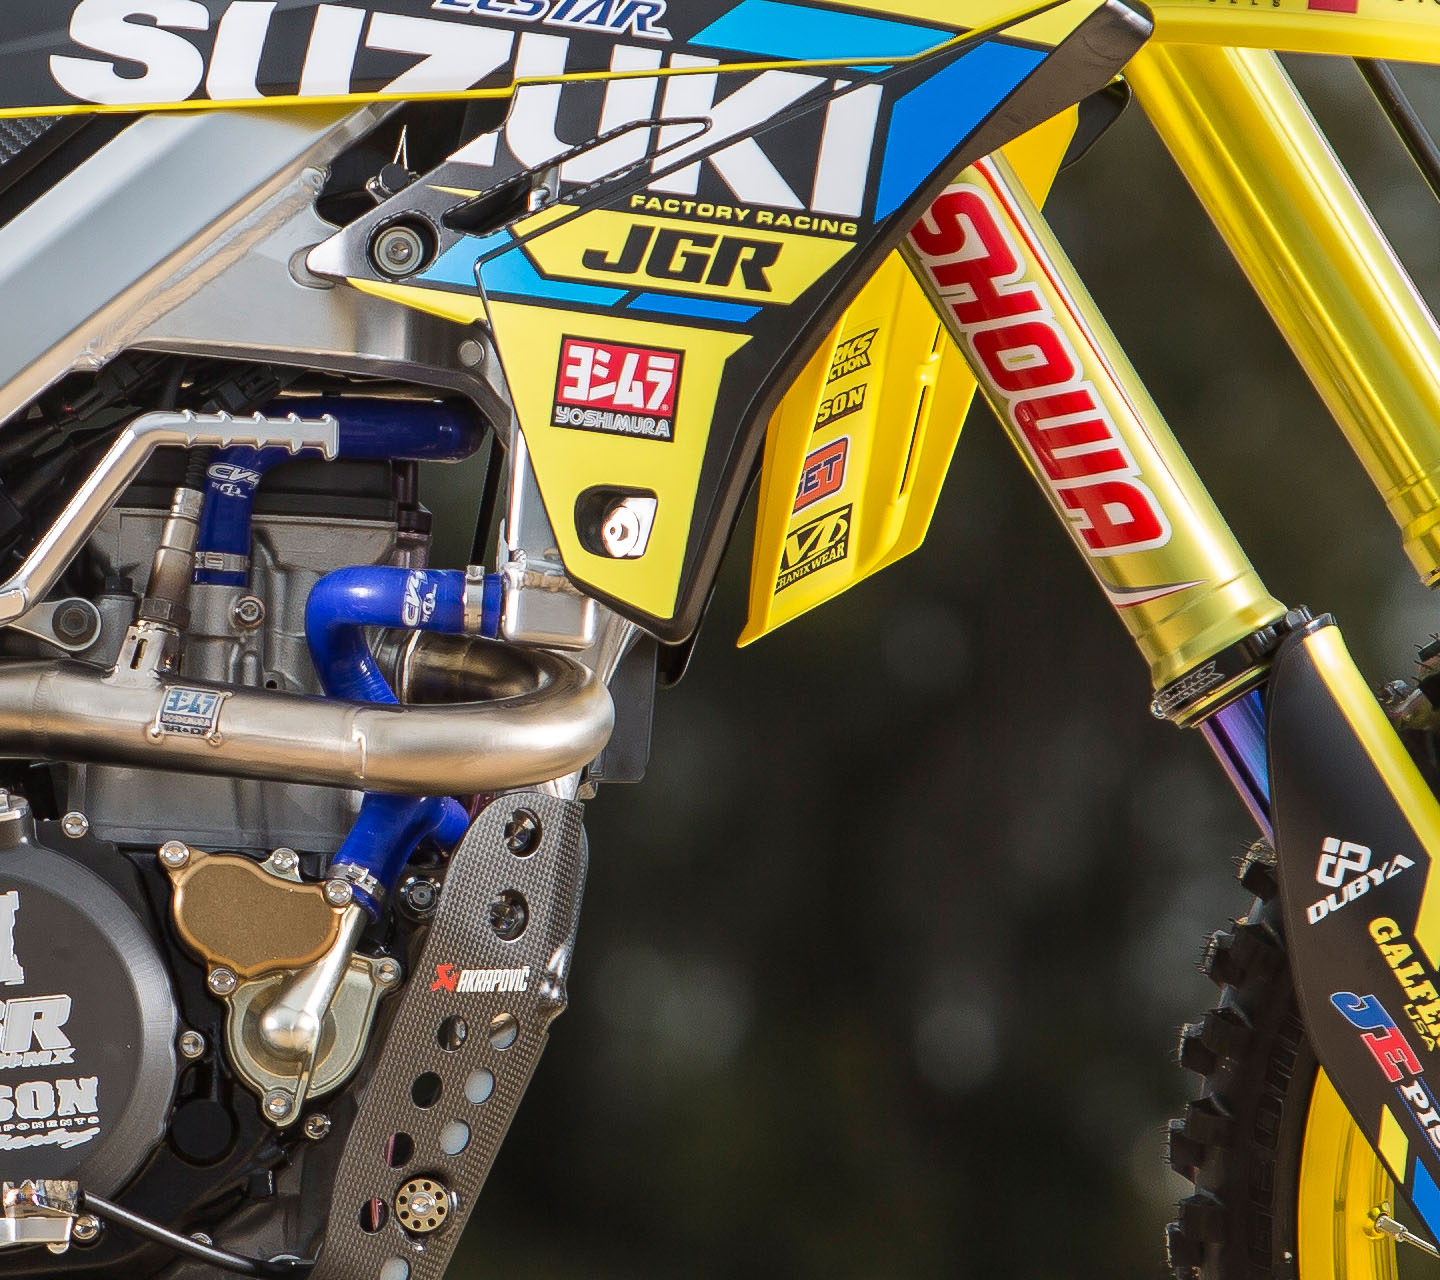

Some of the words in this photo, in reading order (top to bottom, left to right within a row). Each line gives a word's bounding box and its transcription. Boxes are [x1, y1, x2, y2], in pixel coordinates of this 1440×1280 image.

[630, 194, 751, 223] FACTORY
[755, 208, 858, 237] RACING
[582, 225, 784, 293] JGR
[562, 342, 678, 414] ヨシムラ
[910, 186, 1168, 555] SHOWA
[555, 405, 672, 439] YOSHIMURA
[811, 544, 845, 570] WEAR
[1305, 853, 1416, 925] DUBYA
[1330, 991, 1424, 1084] JE
[1402, 1003, 1437, 1052] USA
